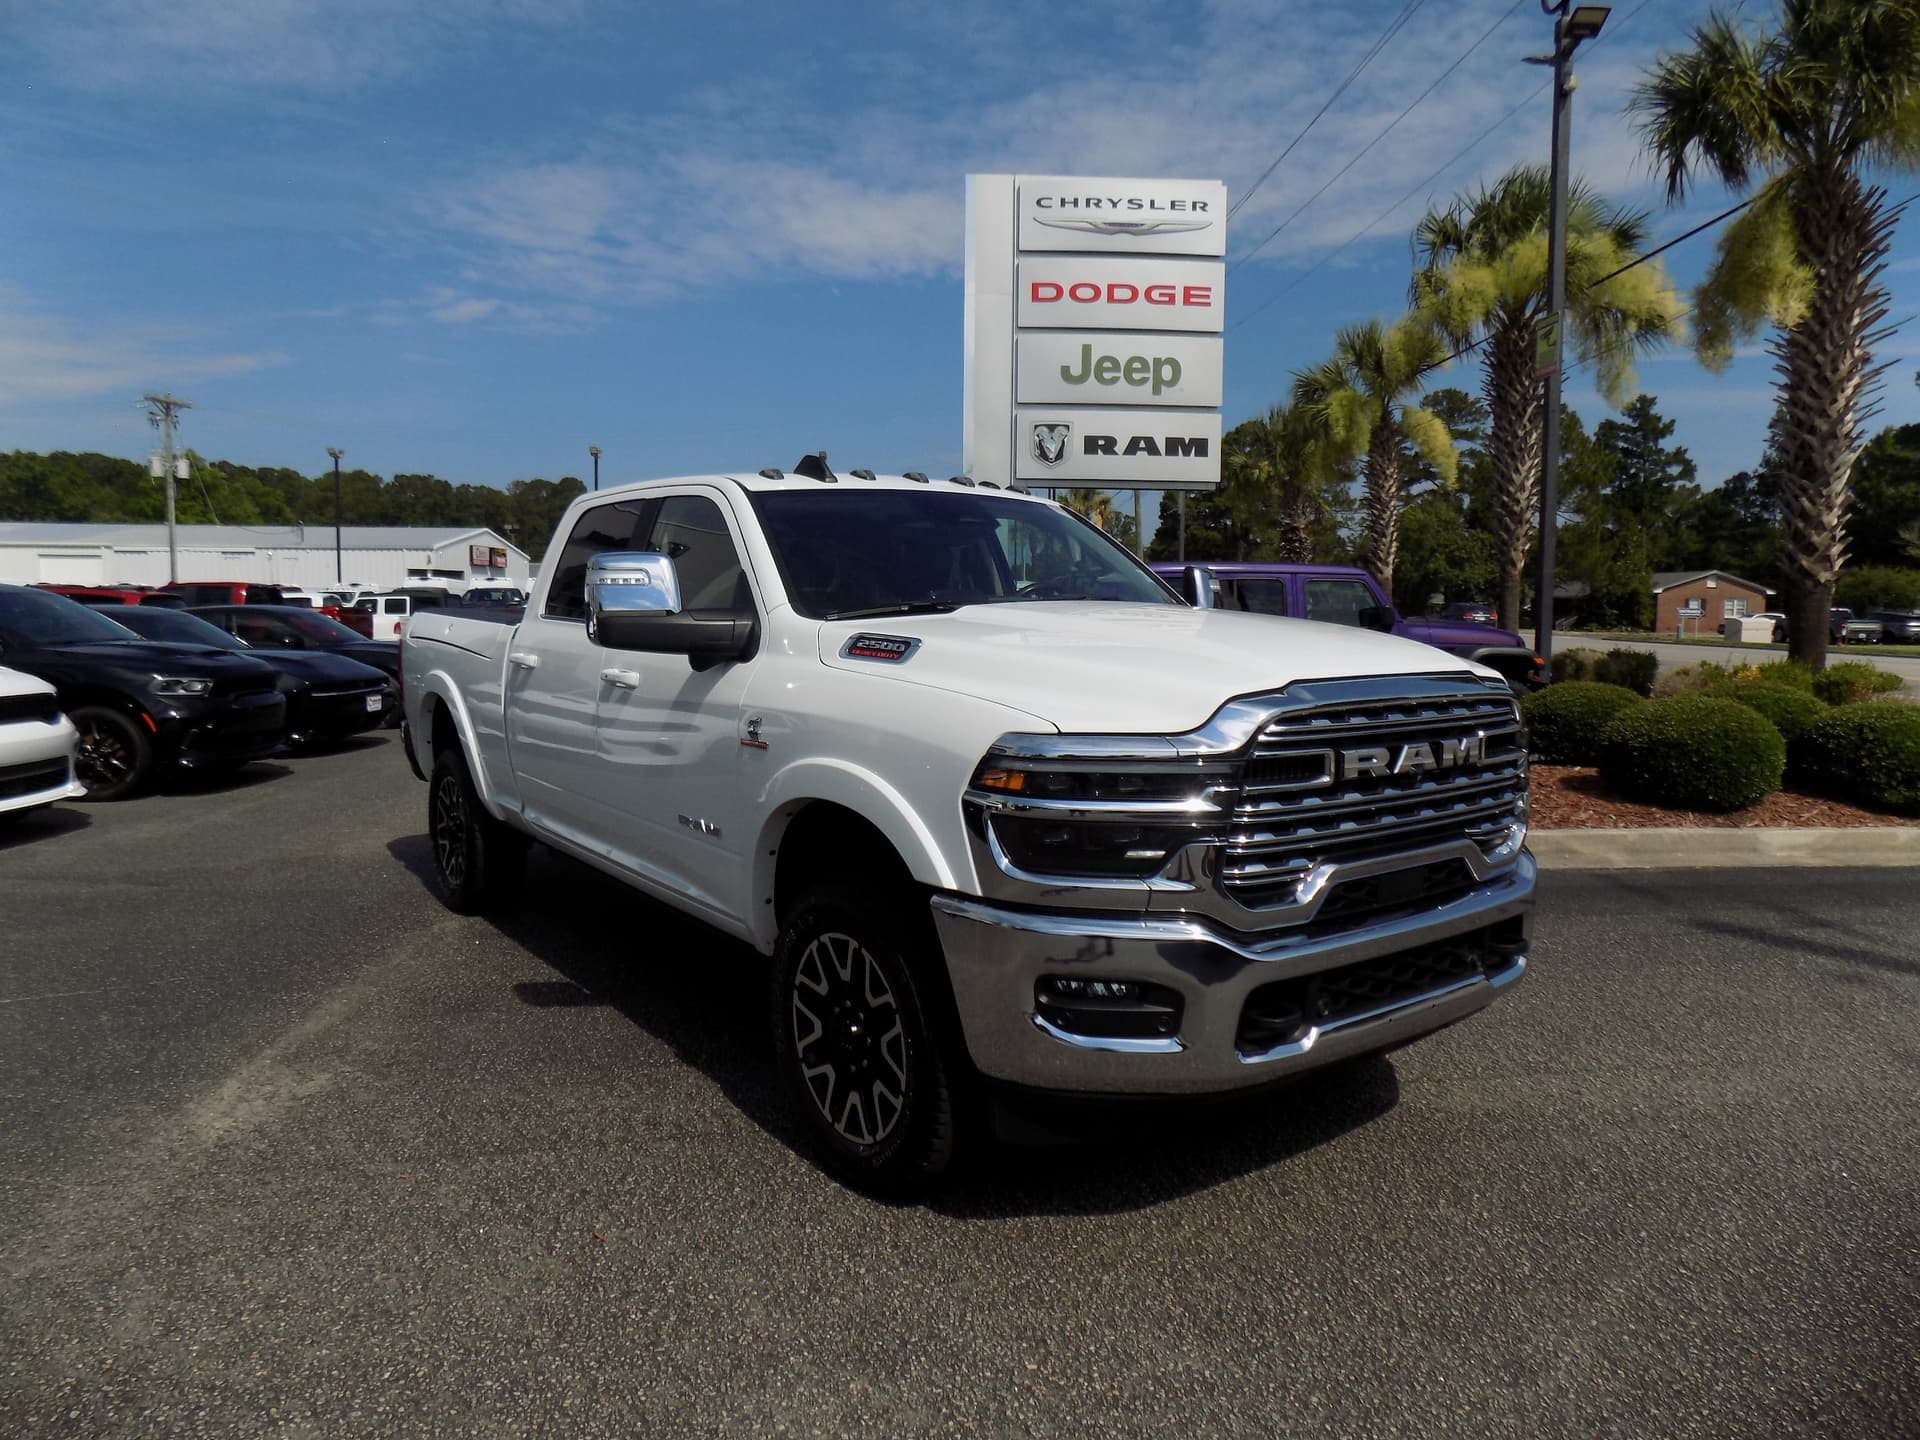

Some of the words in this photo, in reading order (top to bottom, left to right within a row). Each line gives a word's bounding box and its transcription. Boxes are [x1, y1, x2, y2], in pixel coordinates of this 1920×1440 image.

[1035, 197, 1209, 212] CHRYSLER
[1031, 282, 1212, 307] DODGE
[1060, 343, 1182, 396] Jeep
[1083, 435, 1209, 458] RAM
[856, 639, 906, 652] 2500
[1340, 736, 1481, 779] RAM
